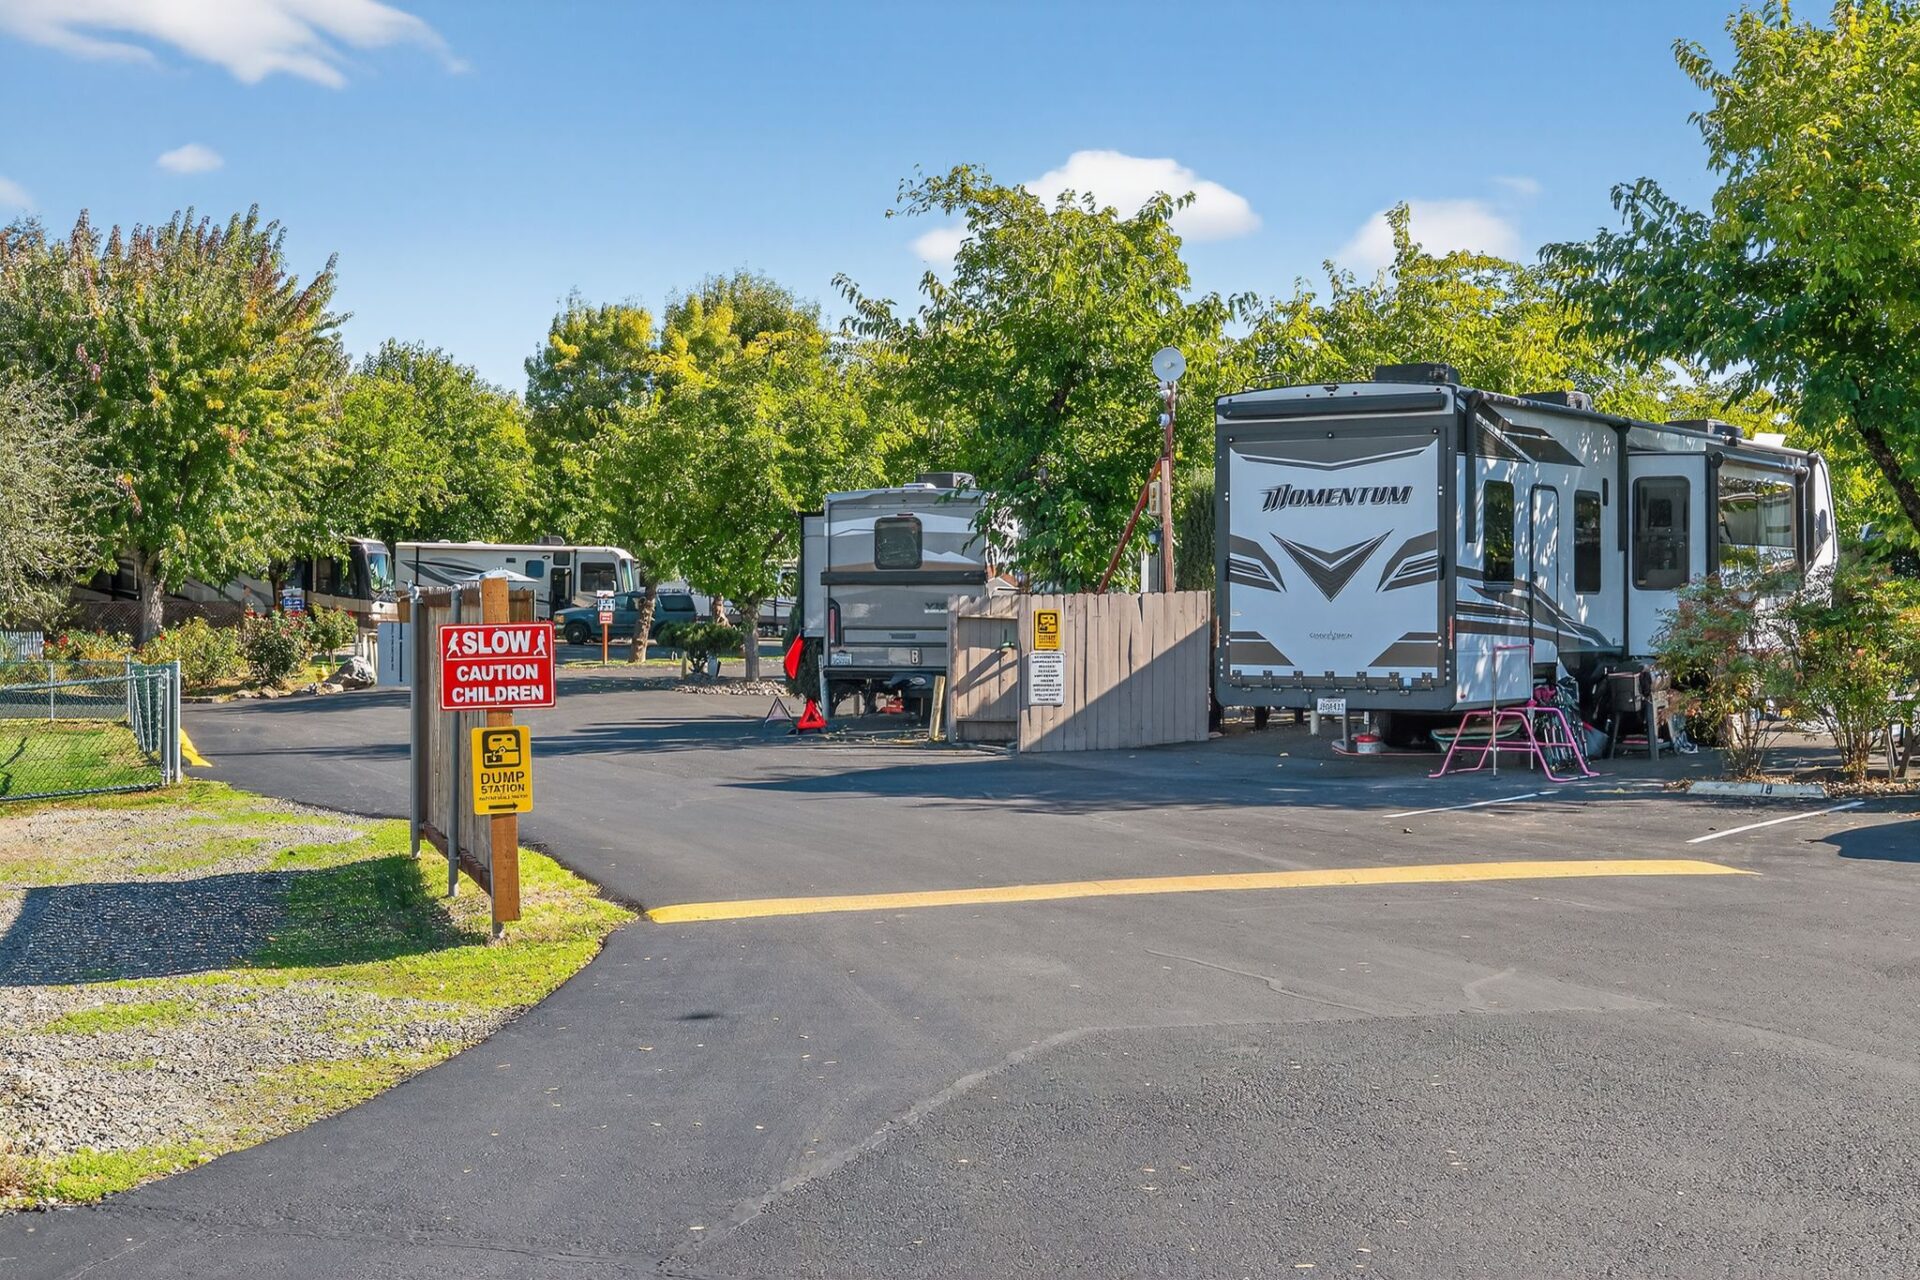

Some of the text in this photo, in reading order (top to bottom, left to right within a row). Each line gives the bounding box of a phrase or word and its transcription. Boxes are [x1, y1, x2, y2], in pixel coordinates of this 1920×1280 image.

[1258, 484, 1413, 512] MOMENTUM
[461, 630, 532, 654] SLOW
[456, 663, 539, 682] CAUTION
[452, 684, 544, 703] CHILDREN
[480, 771, 525, 785] DUMP
[481, 783, 525, 795] STATION
